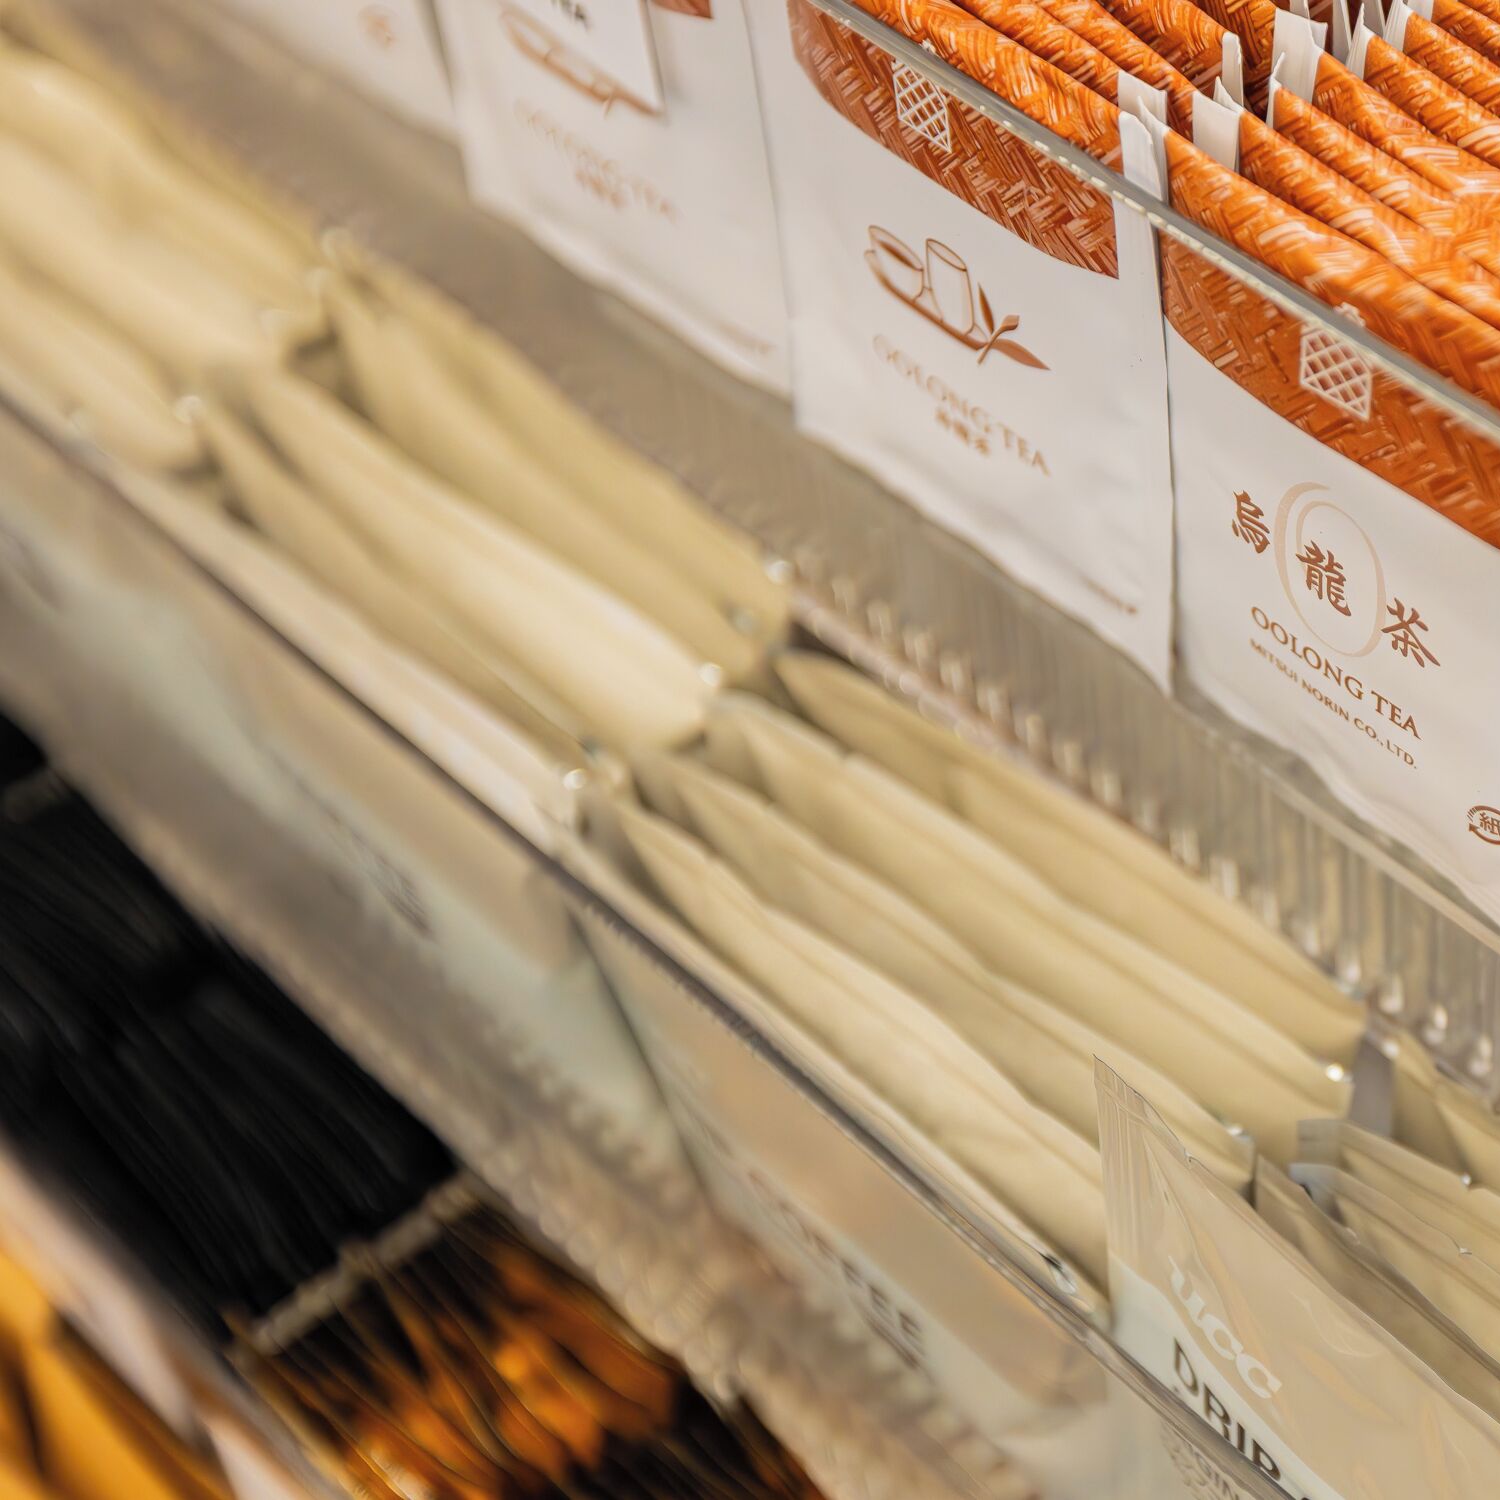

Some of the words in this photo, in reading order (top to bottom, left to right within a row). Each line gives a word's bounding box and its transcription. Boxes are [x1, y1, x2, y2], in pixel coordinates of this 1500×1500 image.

[996, 421, 1051, 478] TEA
[1250, 638, 1299, 683] MITSUI
[1301, 678, 1350, 722] NORIN
[1251, 606, 1364, 700] OOLONG
[1371, 690, 1423, 740] TEA
[1173, 1337, 1282, 1480] DRIP
